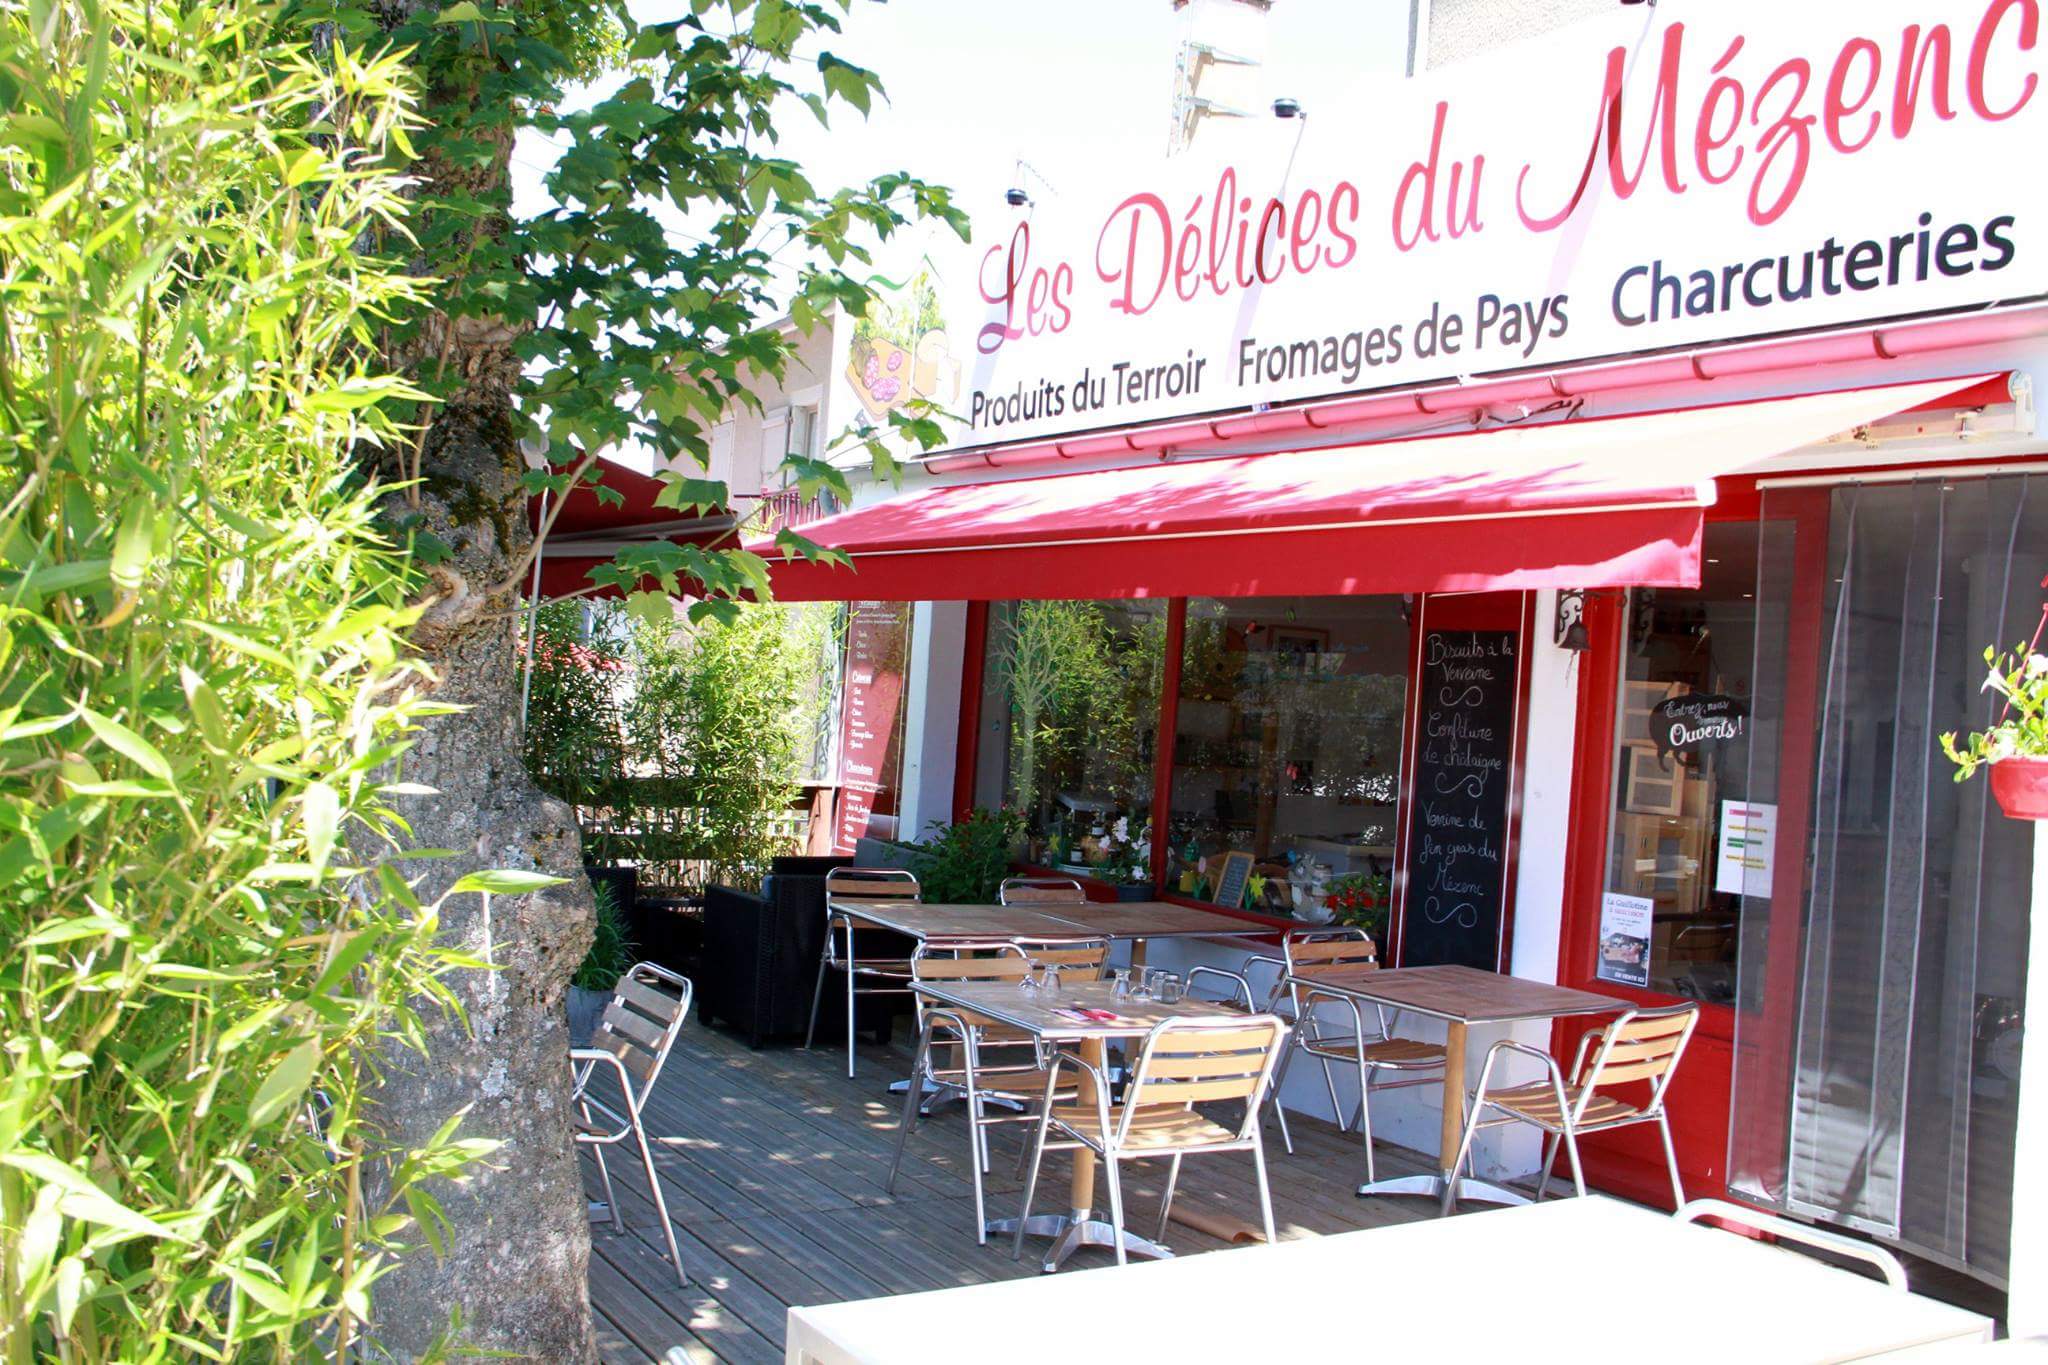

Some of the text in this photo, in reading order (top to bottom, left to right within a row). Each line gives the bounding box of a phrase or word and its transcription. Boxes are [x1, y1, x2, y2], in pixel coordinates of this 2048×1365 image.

[976, 0, 2040, 354] Les Délices du Mézenc
[971, 211, 2016, 430] Produits du Terroir Fromages de Pays Charcuteries
[1426, 632, 1485, 666] Biscuits
[1502, 635, 1514, 656] la
[1427, 710, 1494, 751] Confiture
[1423, 740, 1440, 764] de
[1468, 804, 1487, 830] de
[1419, 833, 1498, 865] fin gras du
